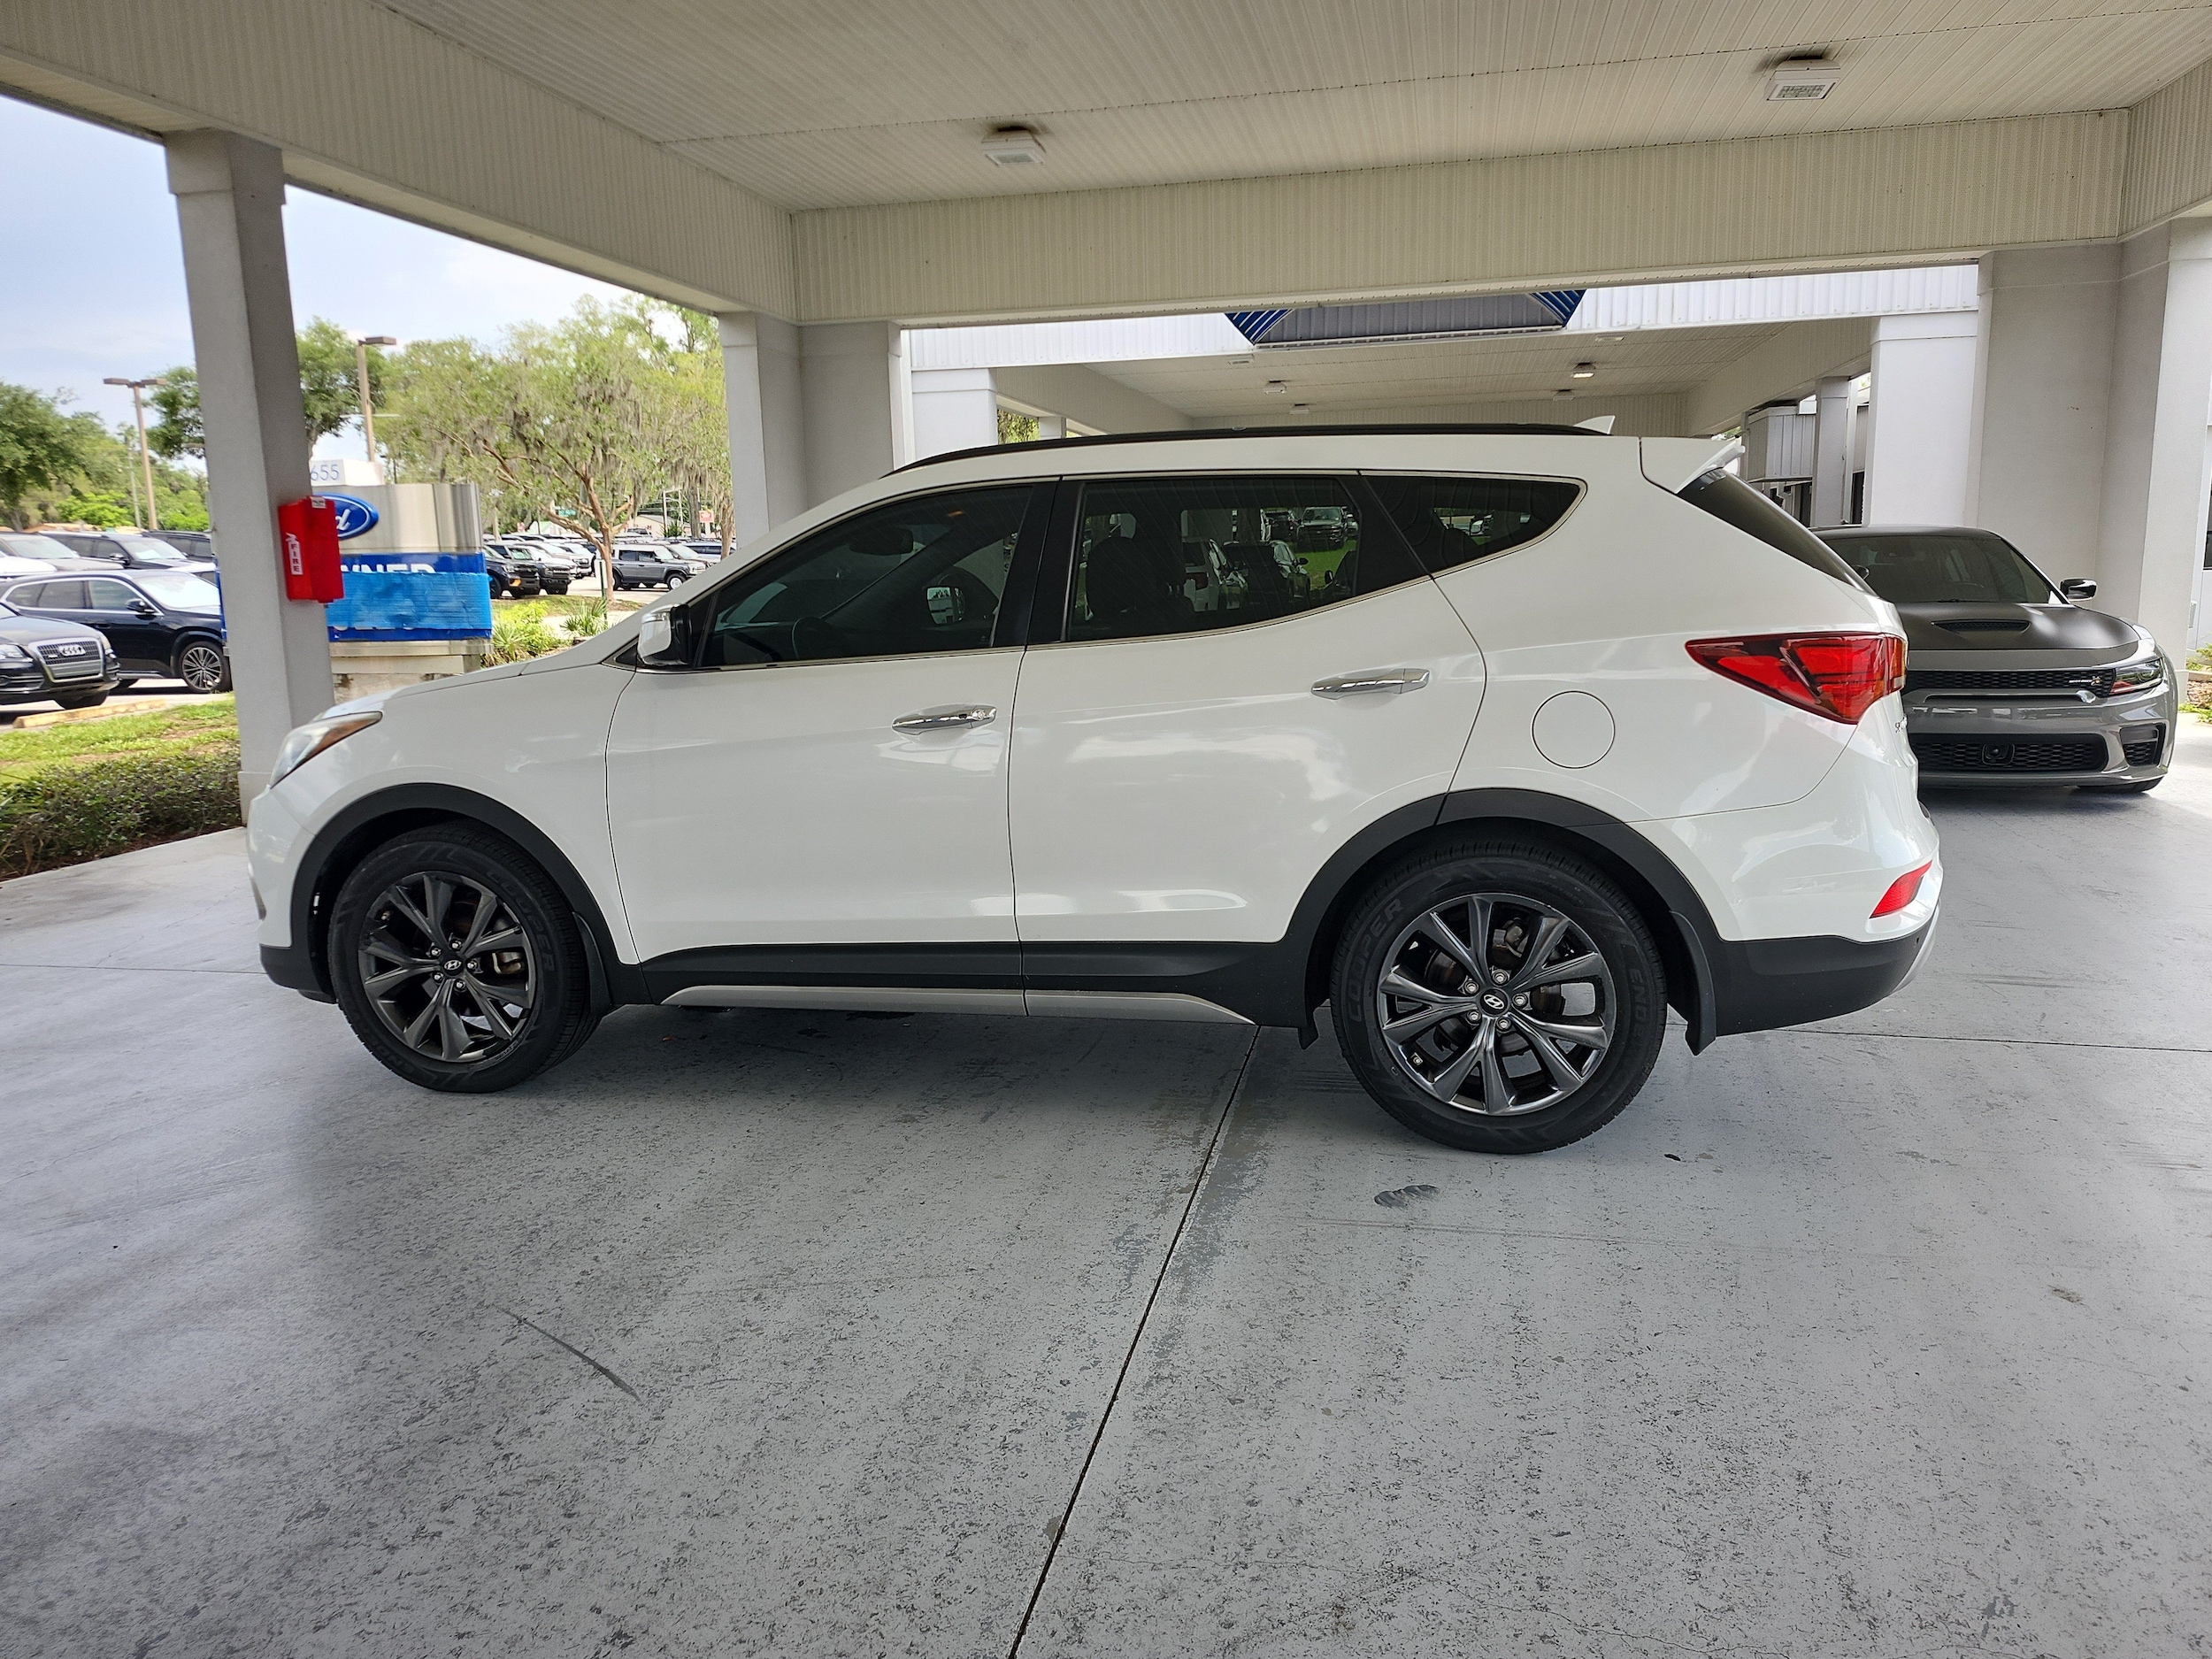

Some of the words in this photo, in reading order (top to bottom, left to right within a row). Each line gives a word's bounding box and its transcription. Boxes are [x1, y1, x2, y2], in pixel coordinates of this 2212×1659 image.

[310, 464, 340, 481] 655
[289, 542, 301, 572] FIRE
[1347, 897, 1405, 1023] COOPER
